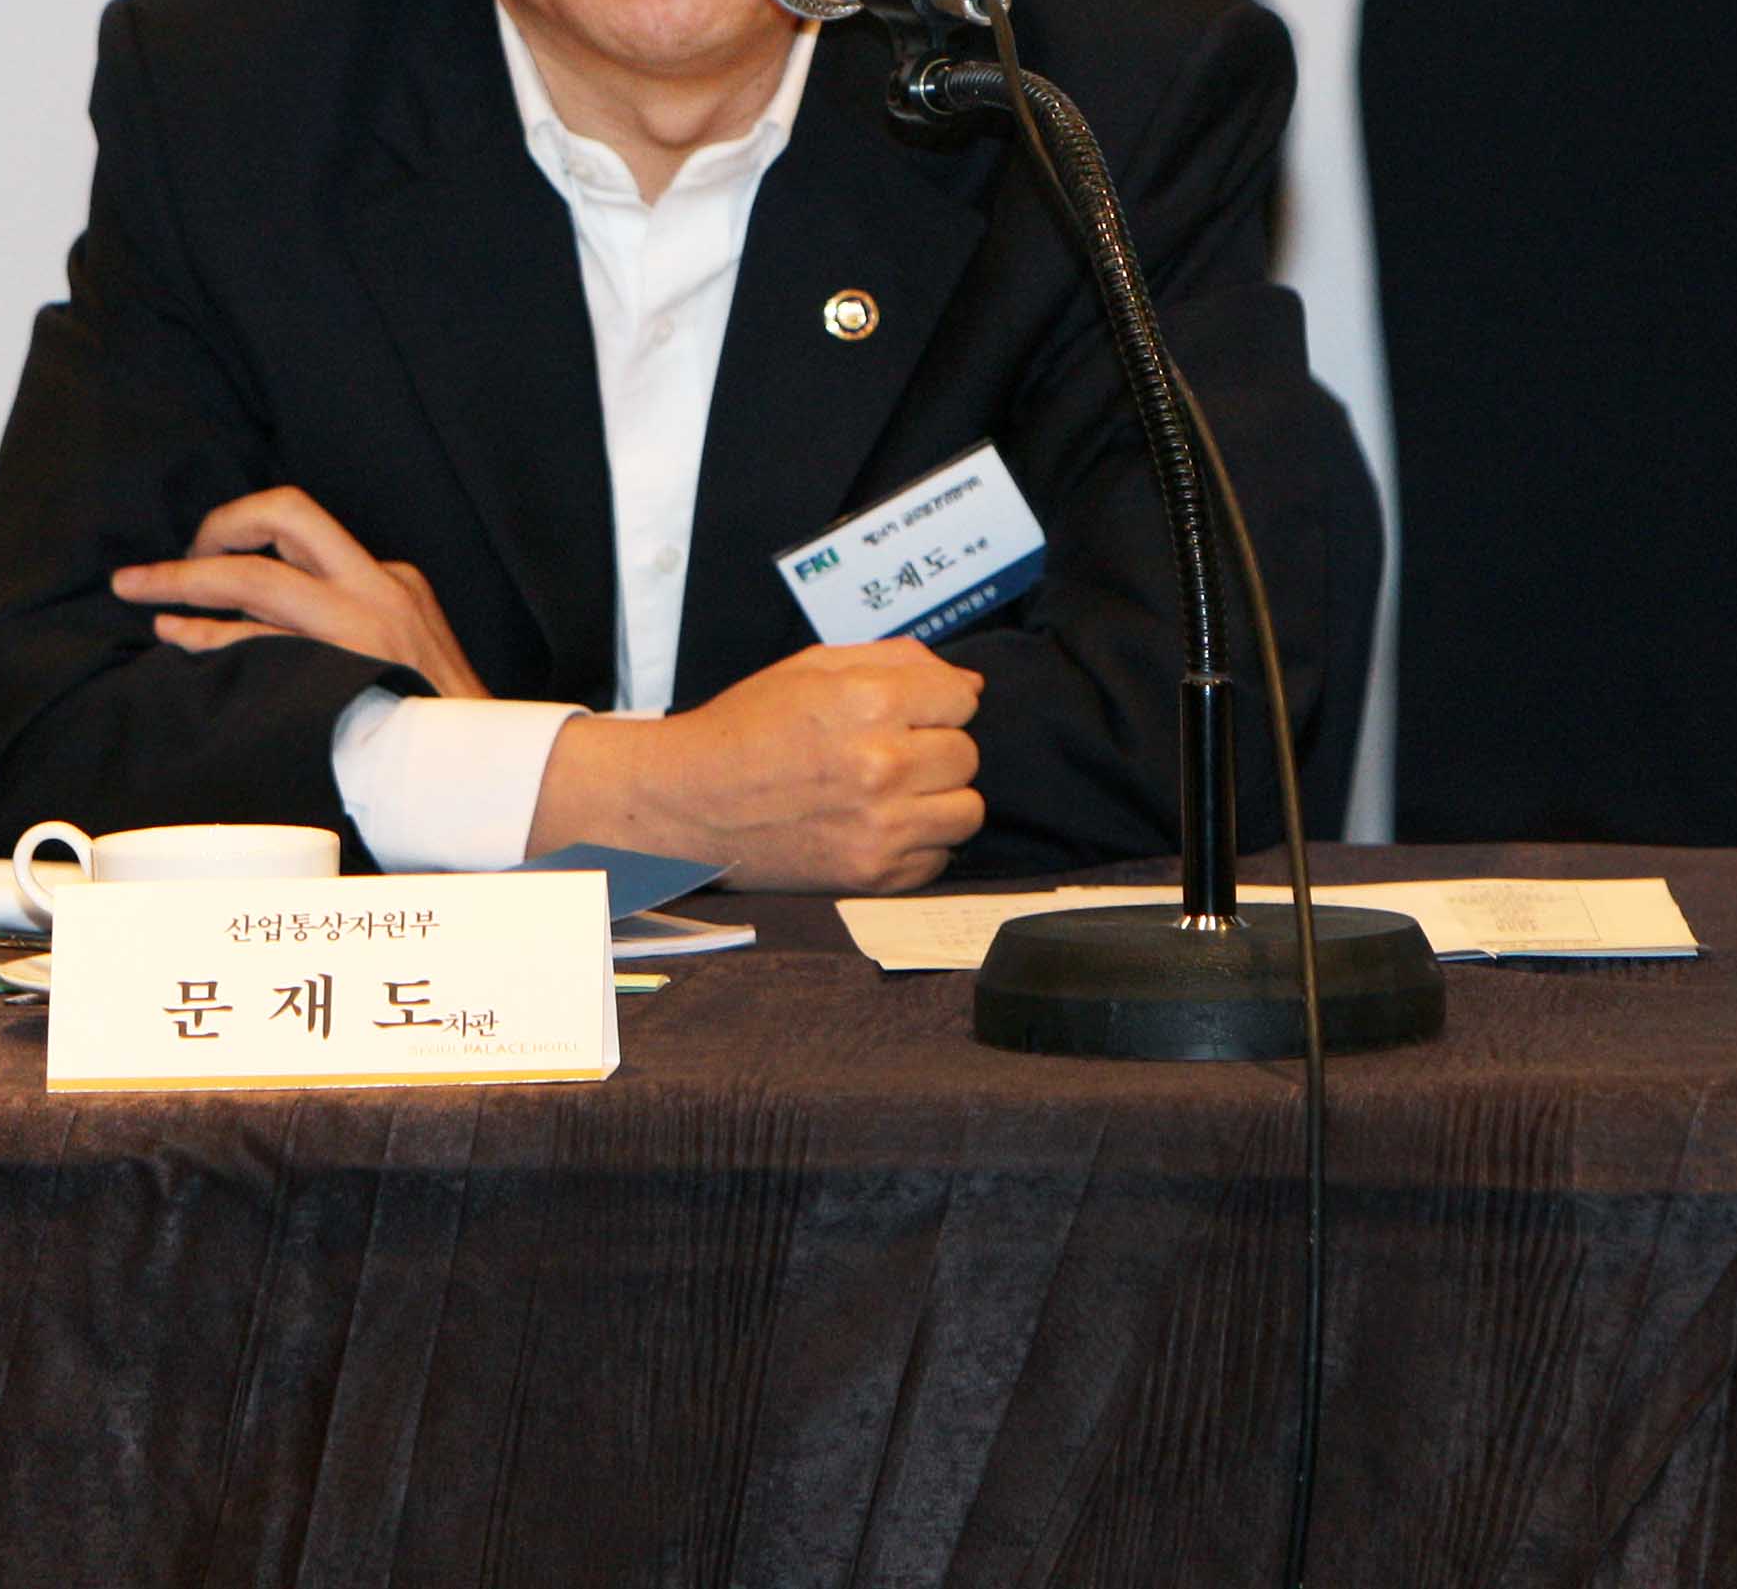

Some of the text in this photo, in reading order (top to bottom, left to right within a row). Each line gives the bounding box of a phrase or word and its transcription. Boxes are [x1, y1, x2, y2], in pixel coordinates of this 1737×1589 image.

[794, 546, 841, 582] FKI
[224, 909, 442, 944] 산업통상자원부
[442, 1008, 500, 1038] 차관
[463, 1041, 528, 1055] PALACE
